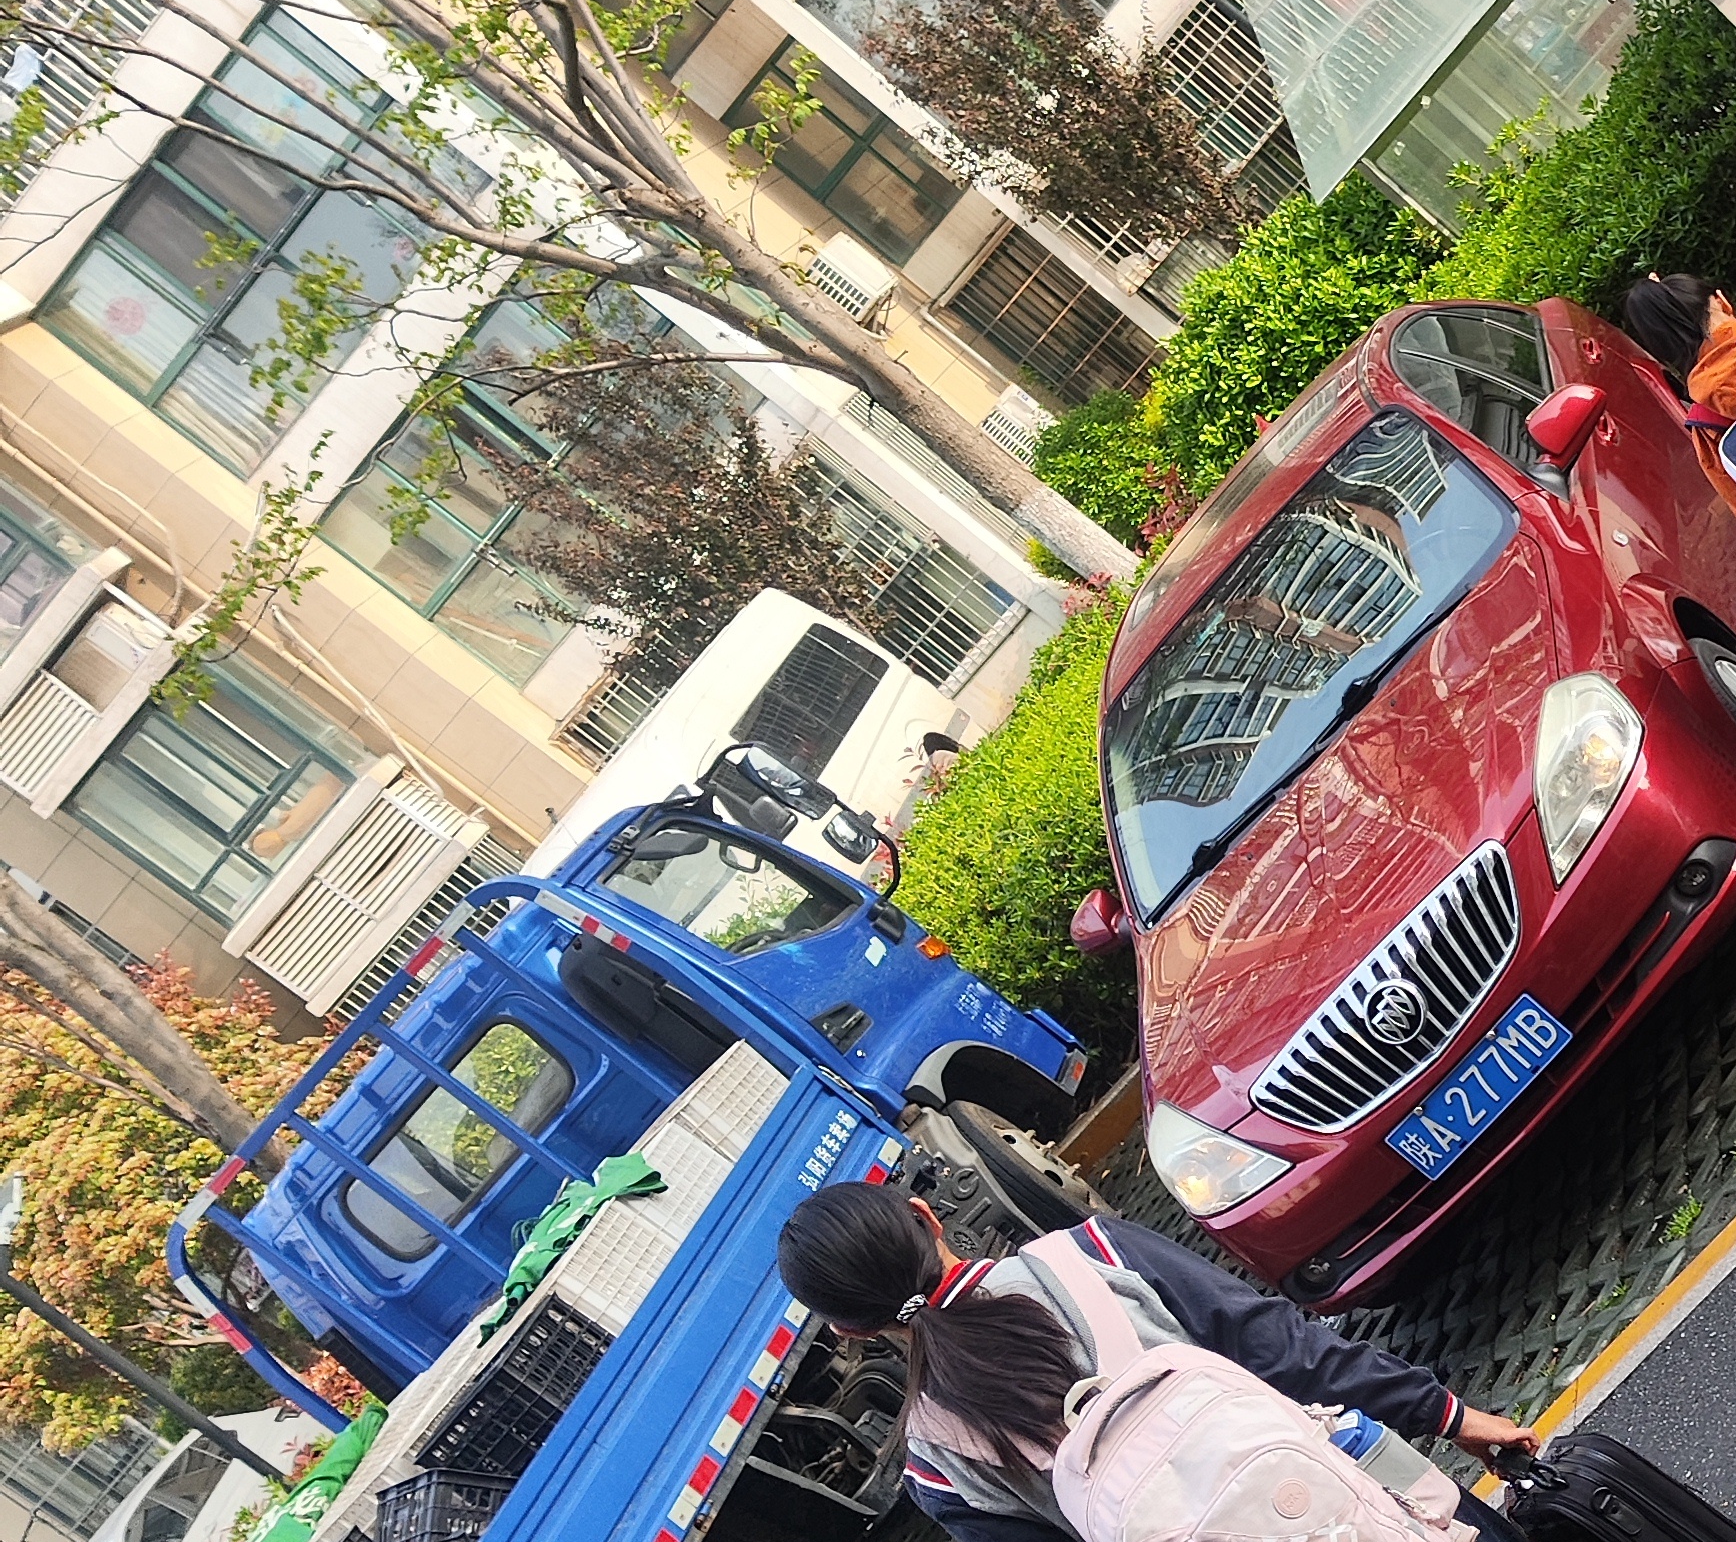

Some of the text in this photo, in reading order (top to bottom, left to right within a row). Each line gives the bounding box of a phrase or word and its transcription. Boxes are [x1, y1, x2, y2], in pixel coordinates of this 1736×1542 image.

[1398, 1009, 1558, 1170] 陕A·277MB
[798, 1110, 858, 1192] 弘阳货车卖场
